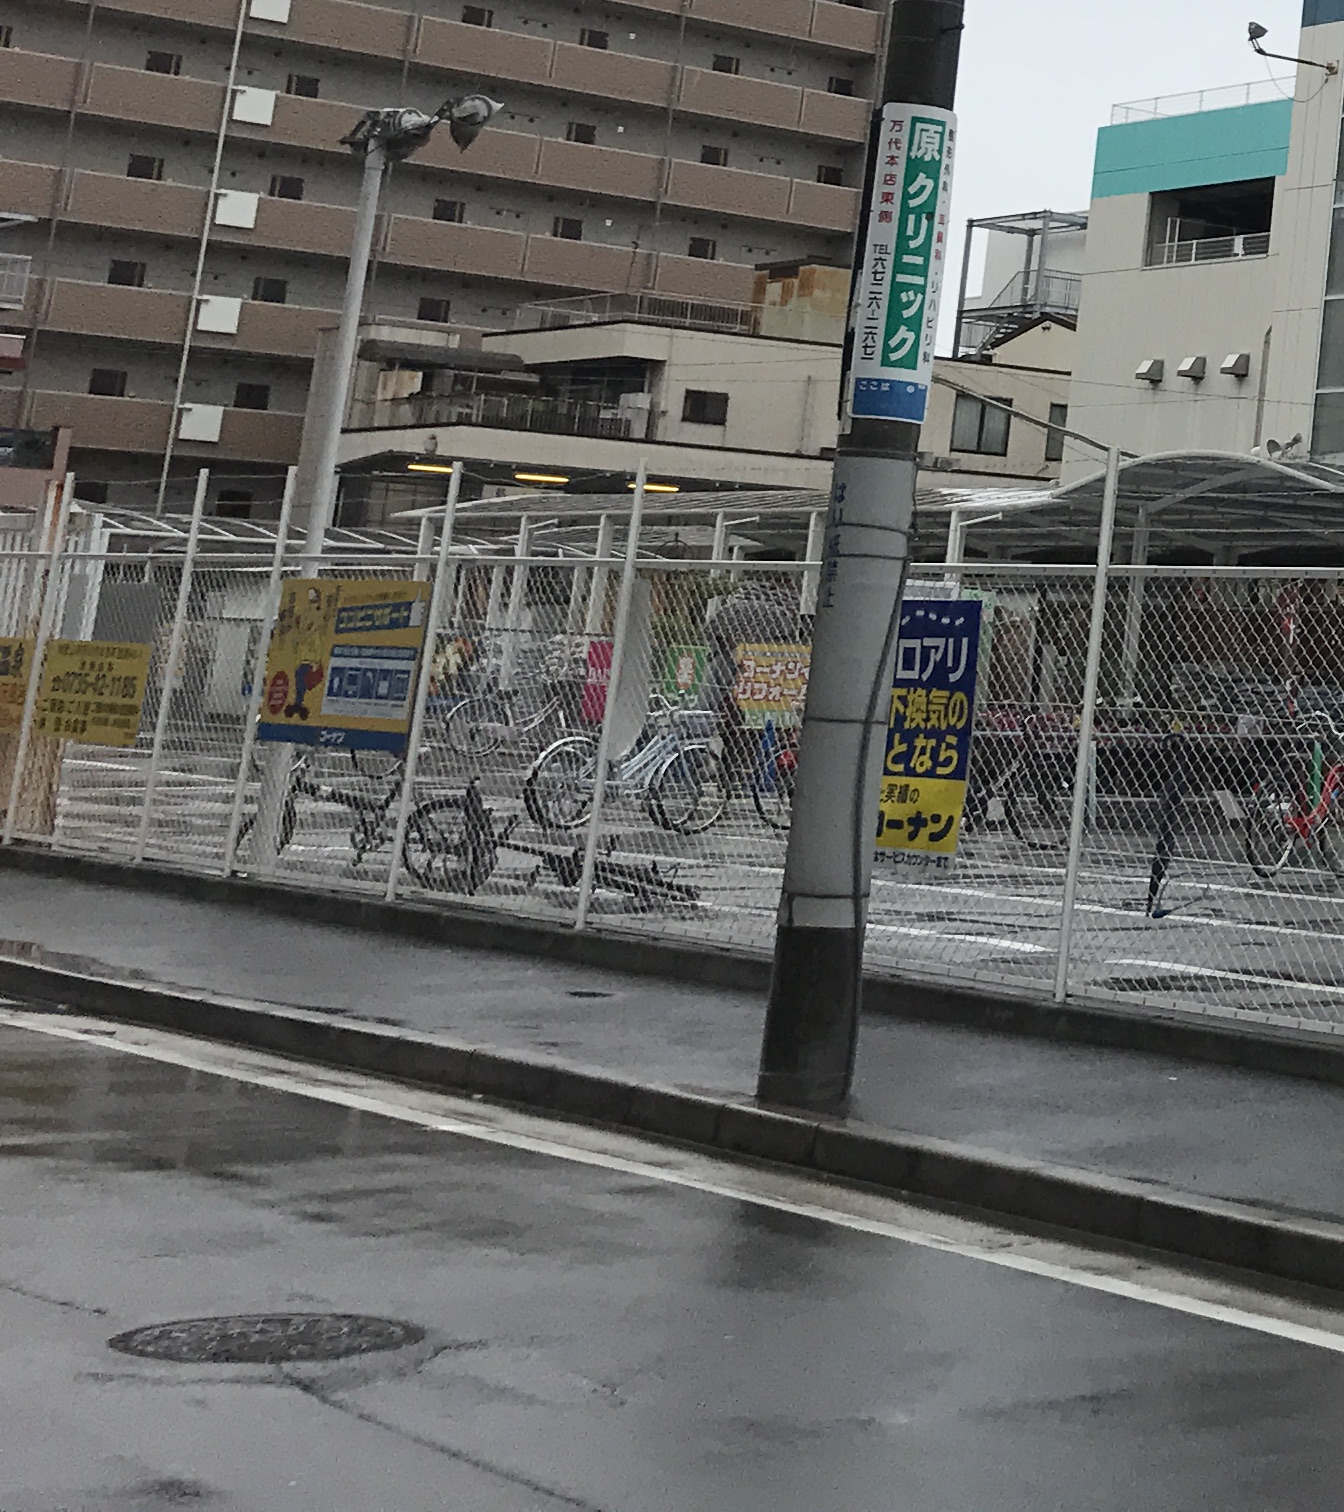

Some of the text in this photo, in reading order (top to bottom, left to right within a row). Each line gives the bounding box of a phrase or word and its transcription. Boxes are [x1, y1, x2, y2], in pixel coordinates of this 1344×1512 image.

[887, 121, 943, 362] 原クリニック
